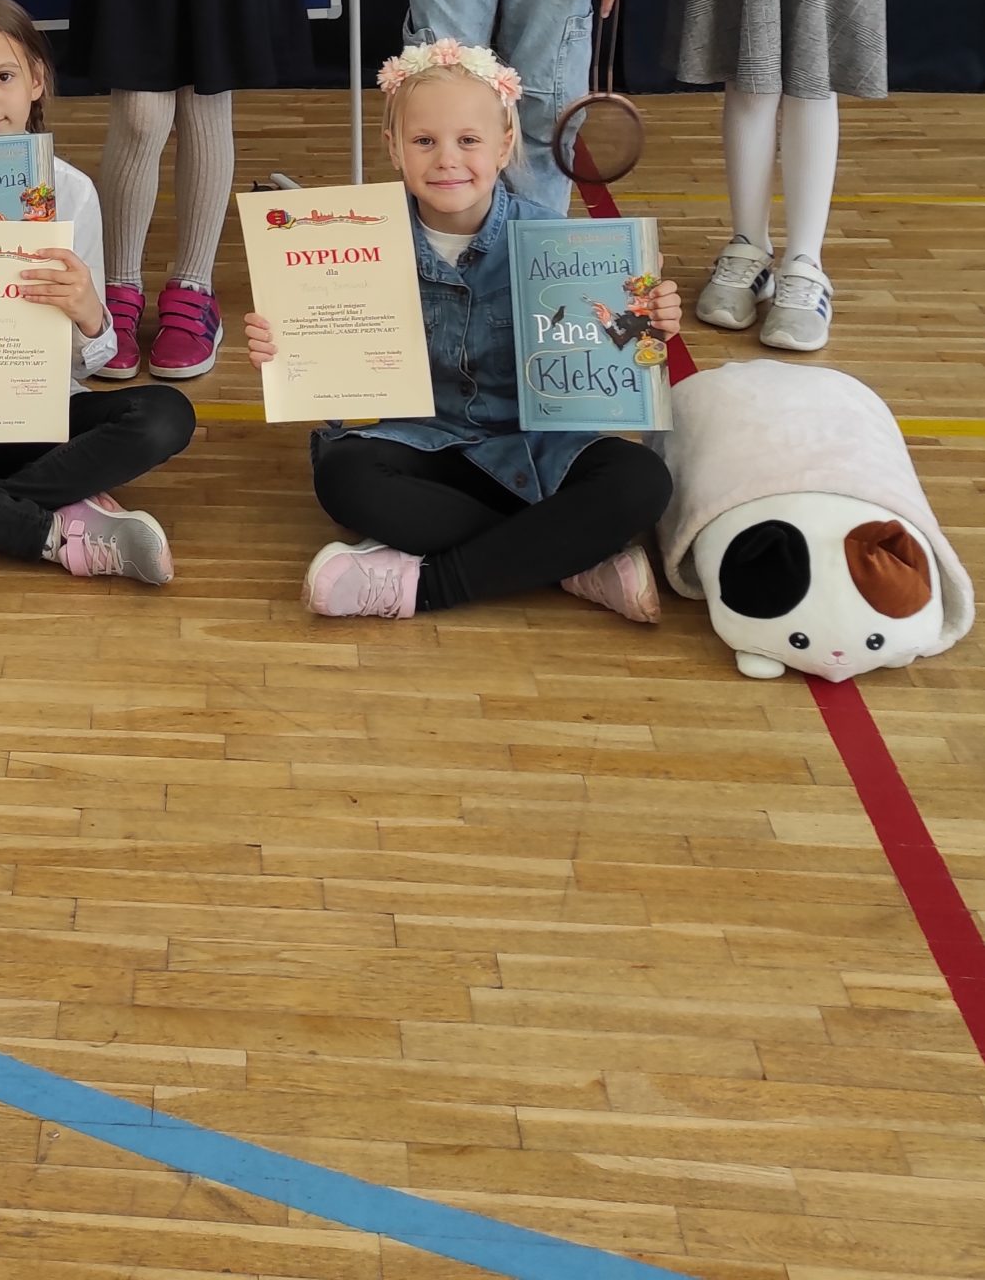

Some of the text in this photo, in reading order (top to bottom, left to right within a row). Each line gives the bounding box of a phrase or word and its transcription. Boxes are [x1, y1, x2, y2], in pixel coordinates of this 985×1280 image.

[285, 246, 382, 267] DYPLOM
[528, 251, 632, 281] Akademia
[325, 268, 339, 277] dla
[533, 314, 603, 345] Pana
[535, 350, 640, 397] Kleksa
